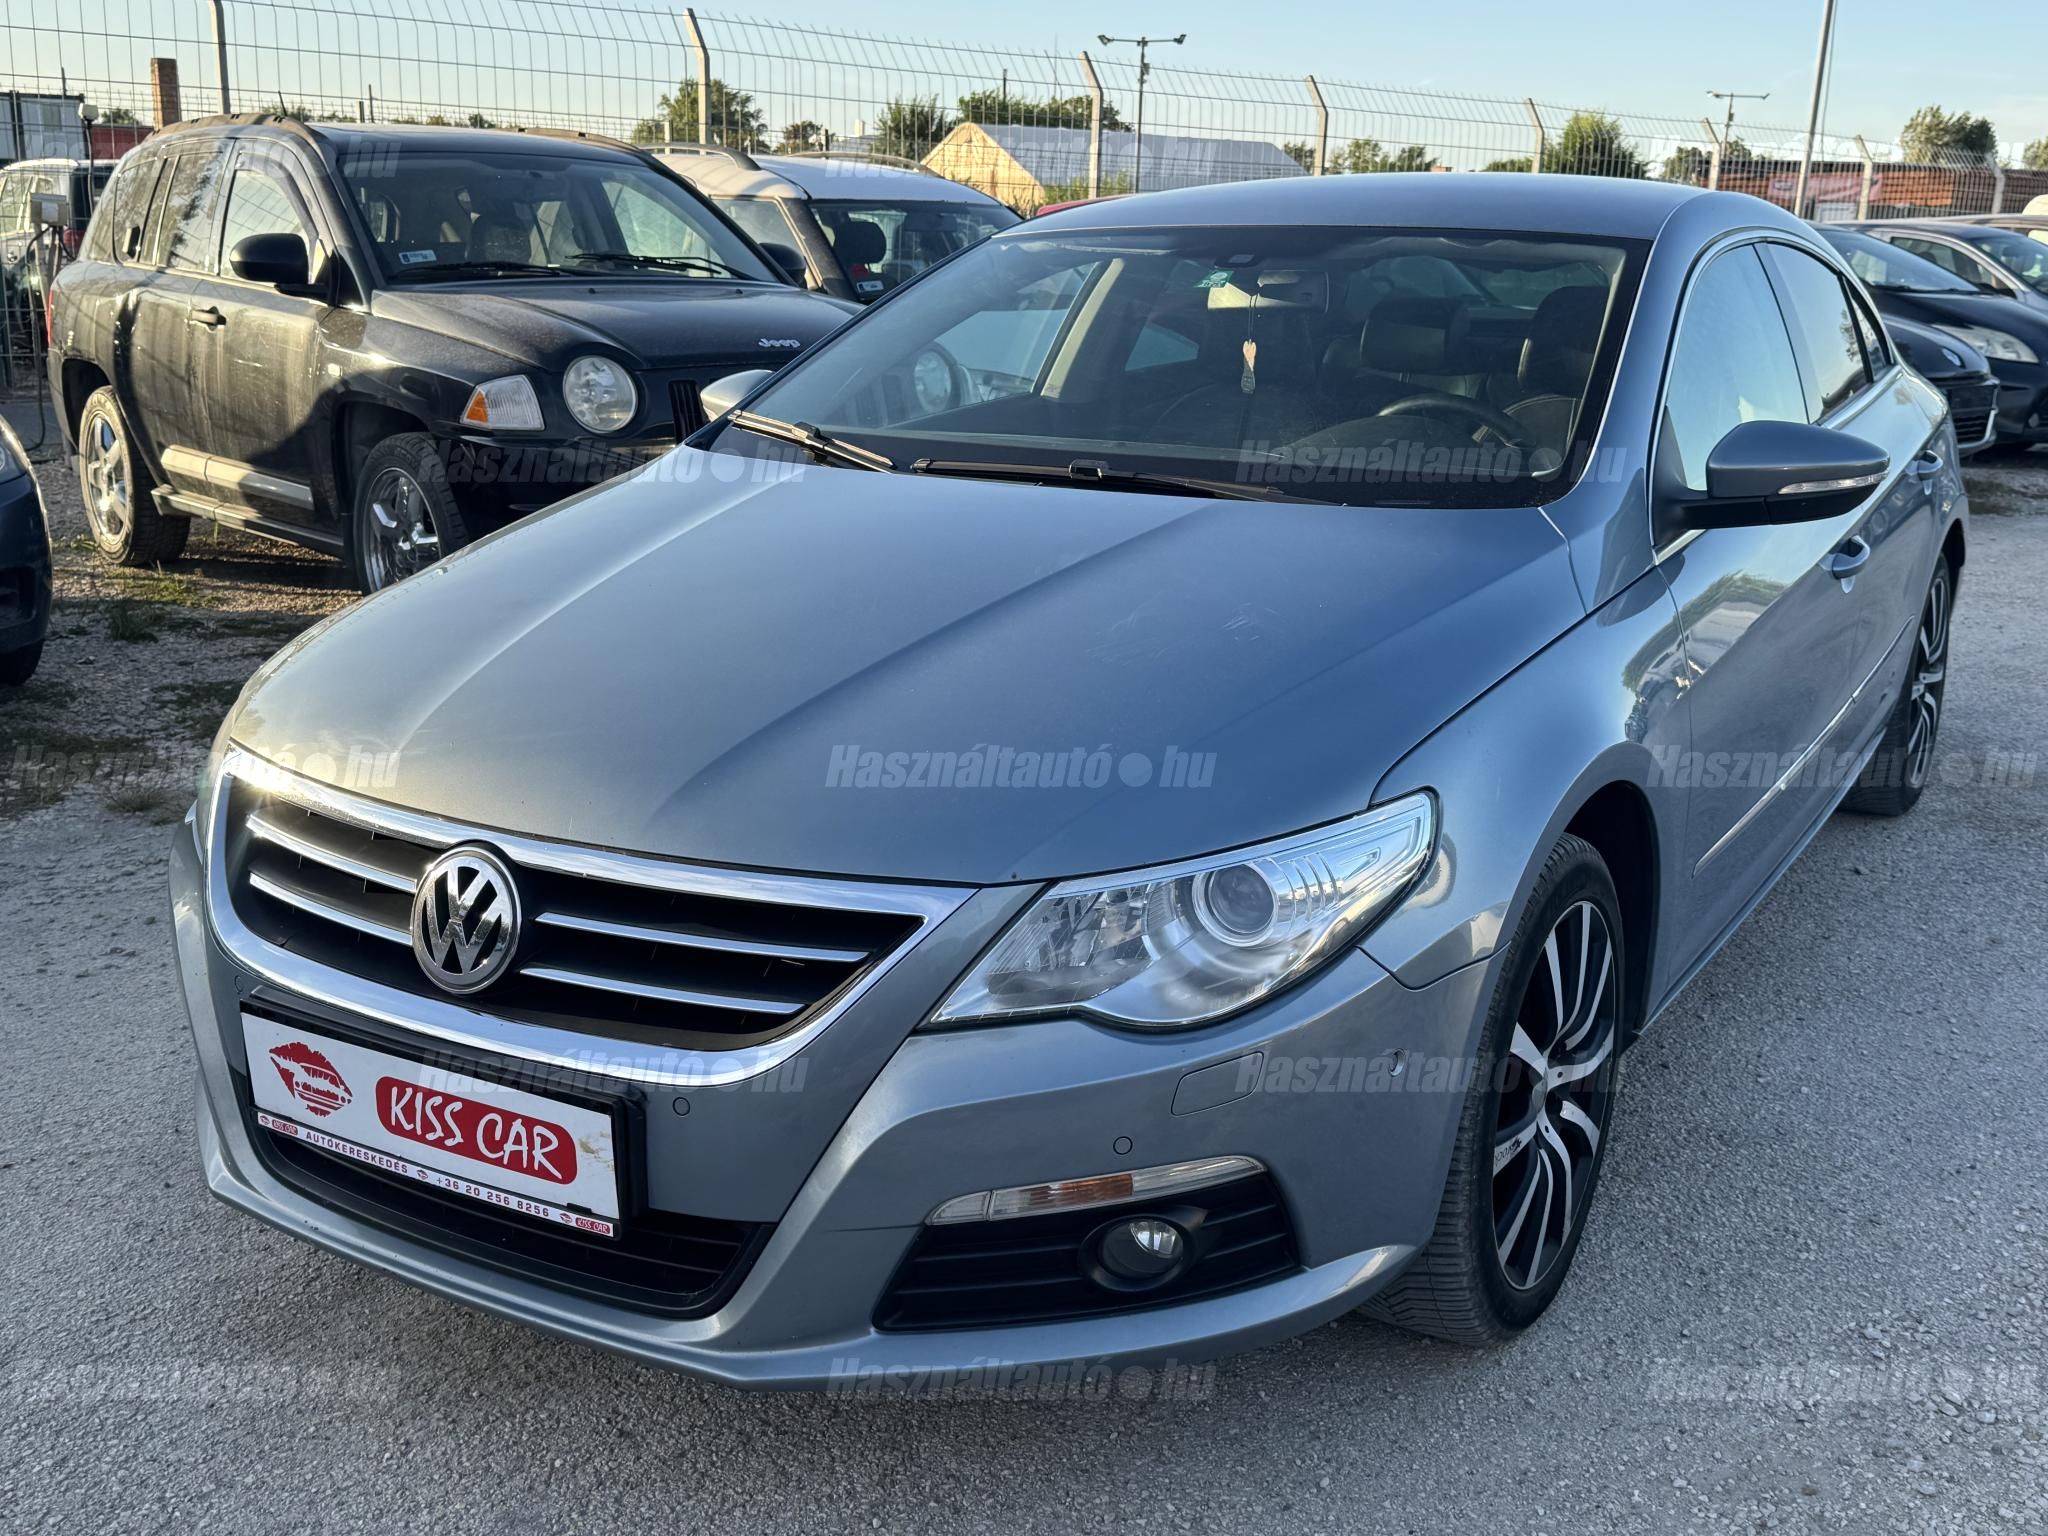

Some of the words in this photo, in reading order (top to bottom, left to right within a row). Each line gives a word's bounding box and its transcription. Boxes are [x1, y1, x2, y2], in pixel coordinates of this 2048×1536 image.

[758, 338, 801, 348] Jeep
[306, 1130, 408, 1174] AUTÓKERESKEDÉS
[390, 1086, 464, 1147] KISS
[476, 1112, 562, 1180] CAR
[436, 1176, 460, 1191] +36
[465, 1184, 481, 1197] 20
[486, 1191, 510, 1206] 256
[517, 1200, 550, 1218] 8256
[577, 1217, 592, 1230] KISS
[593, 1222, 609, 1234] CAR
